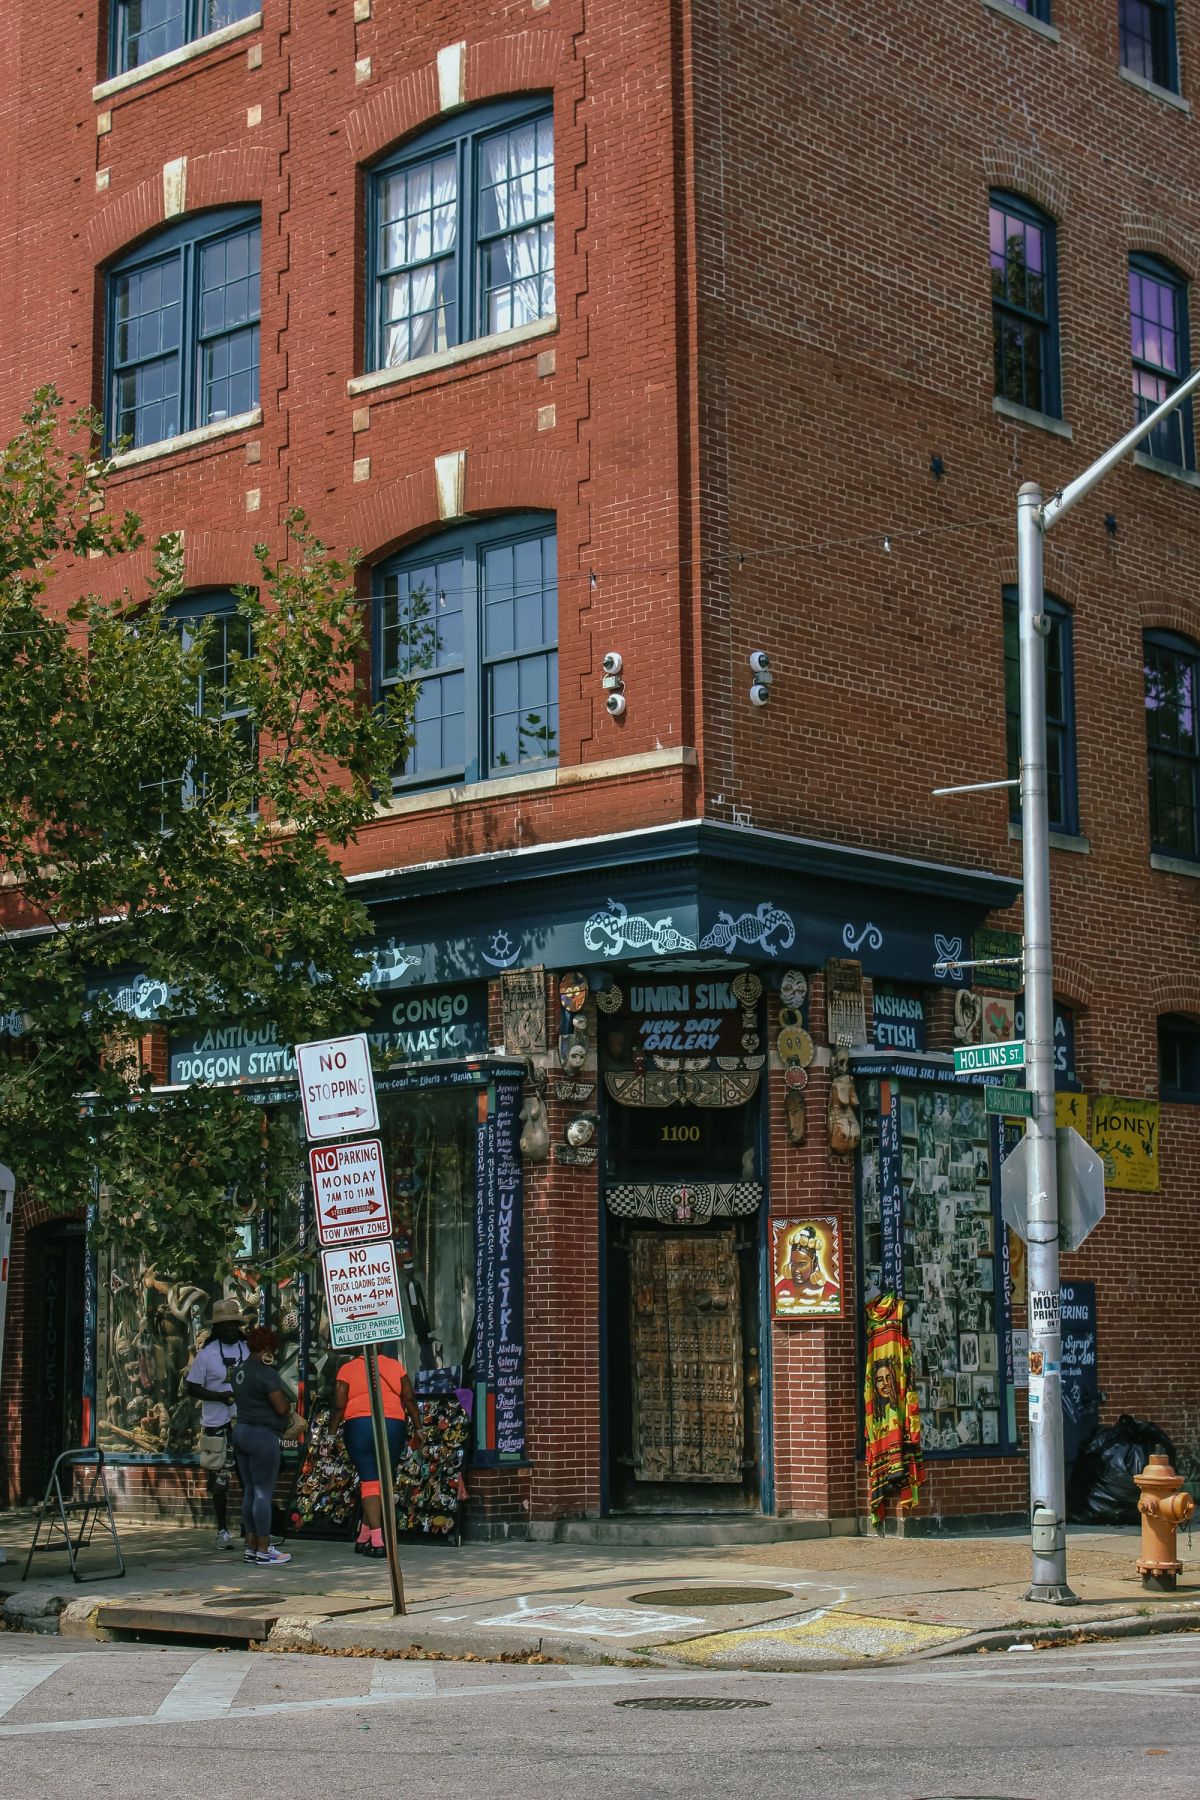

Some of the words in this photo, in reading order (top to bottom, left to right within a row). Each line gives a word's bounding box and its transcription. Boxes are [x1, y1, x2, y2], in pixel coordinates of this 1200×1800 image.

[630, 985, 690, 1012] UMRI
[392, 994, 468, 1025] CONGO
[639, 1020, 680, 1034] NEW
[683, 1018, 722, 1033] DAY
[388, 1025, 461, 1053] MASK
[643, 1033, 721, 1050] GALERY
[319, 1052, 347, 1072] NO
[960, 1042, 1007, 1069] HOLLINS
[1010, 1049, 1021, 1061] ST.
[177, 1056, 240, 1085] DOGON
[895, 1064, 917, 1076] UMRI
[919, 1067, 935, 1080] SIKI
[938, 1070, 955, 1081] NEW
[972, 1074, 998, 1086] GALERY
[308, 1078, 366, 1102] STOPPING
[661, 1126, 700, 1141] 1100
[1096, 1115, 1155, 1141] HONEY
[314, 1151, 337, 1172] NO
[338, 1147, 377, 1166] PARKING
[322, 1170, 376, 1189] MONDAY
[487, 1158, 495, 1206] BUTTER
[882, 1157, 890, 1188] DAY
[326, 1192, 342, 1203] 7AM
[344, 1190, 354, 1200] TO
[357, 1187, 375, 1198] 11AM
[331, 1208, 348, 1217] STREET
[350, 1204, 374, 1214] CLEANING
[324, 1229, 341, 1240] TOW
[343, 1226, 365, 1238] AWAY
[367, 1221, 386, 1234] ZONE
[487, 1214, 495, 1254] SOAPS
[498, 1193, 514, 1260] UMRI
[348, 1249, 367, 1264] NO
[329, 1261, 390, 1281] PARKING
[331, 1283, 350, 1293] TRUCK
[351, 1278, 375, 1290] LOADING
[377, 1275, 392, 1286] ZONE
[1060, 1287, 1074, 1300] NO
[332, 1288, 394, 1306] 10AM-4PM
[498, 1268, 512, 1342] SIKI
[1033, 1296, 1059, 1310] MOG
[358, 1303, 375, 1311] THRU
[1033, 1310, 1059, 1320] PRINT
[335, 1323, 367, 1334] METERED
[369, 1317, 399, 1329] PARKING
[338, 1334, 352, 1344] ALL
[354, 1331, 377, 1340] OTHER
[380, 1327, 399, 1336] TIMES
[487, 1339, 495, 1379] OILS
[503, 1411, 514, 1419] NO
